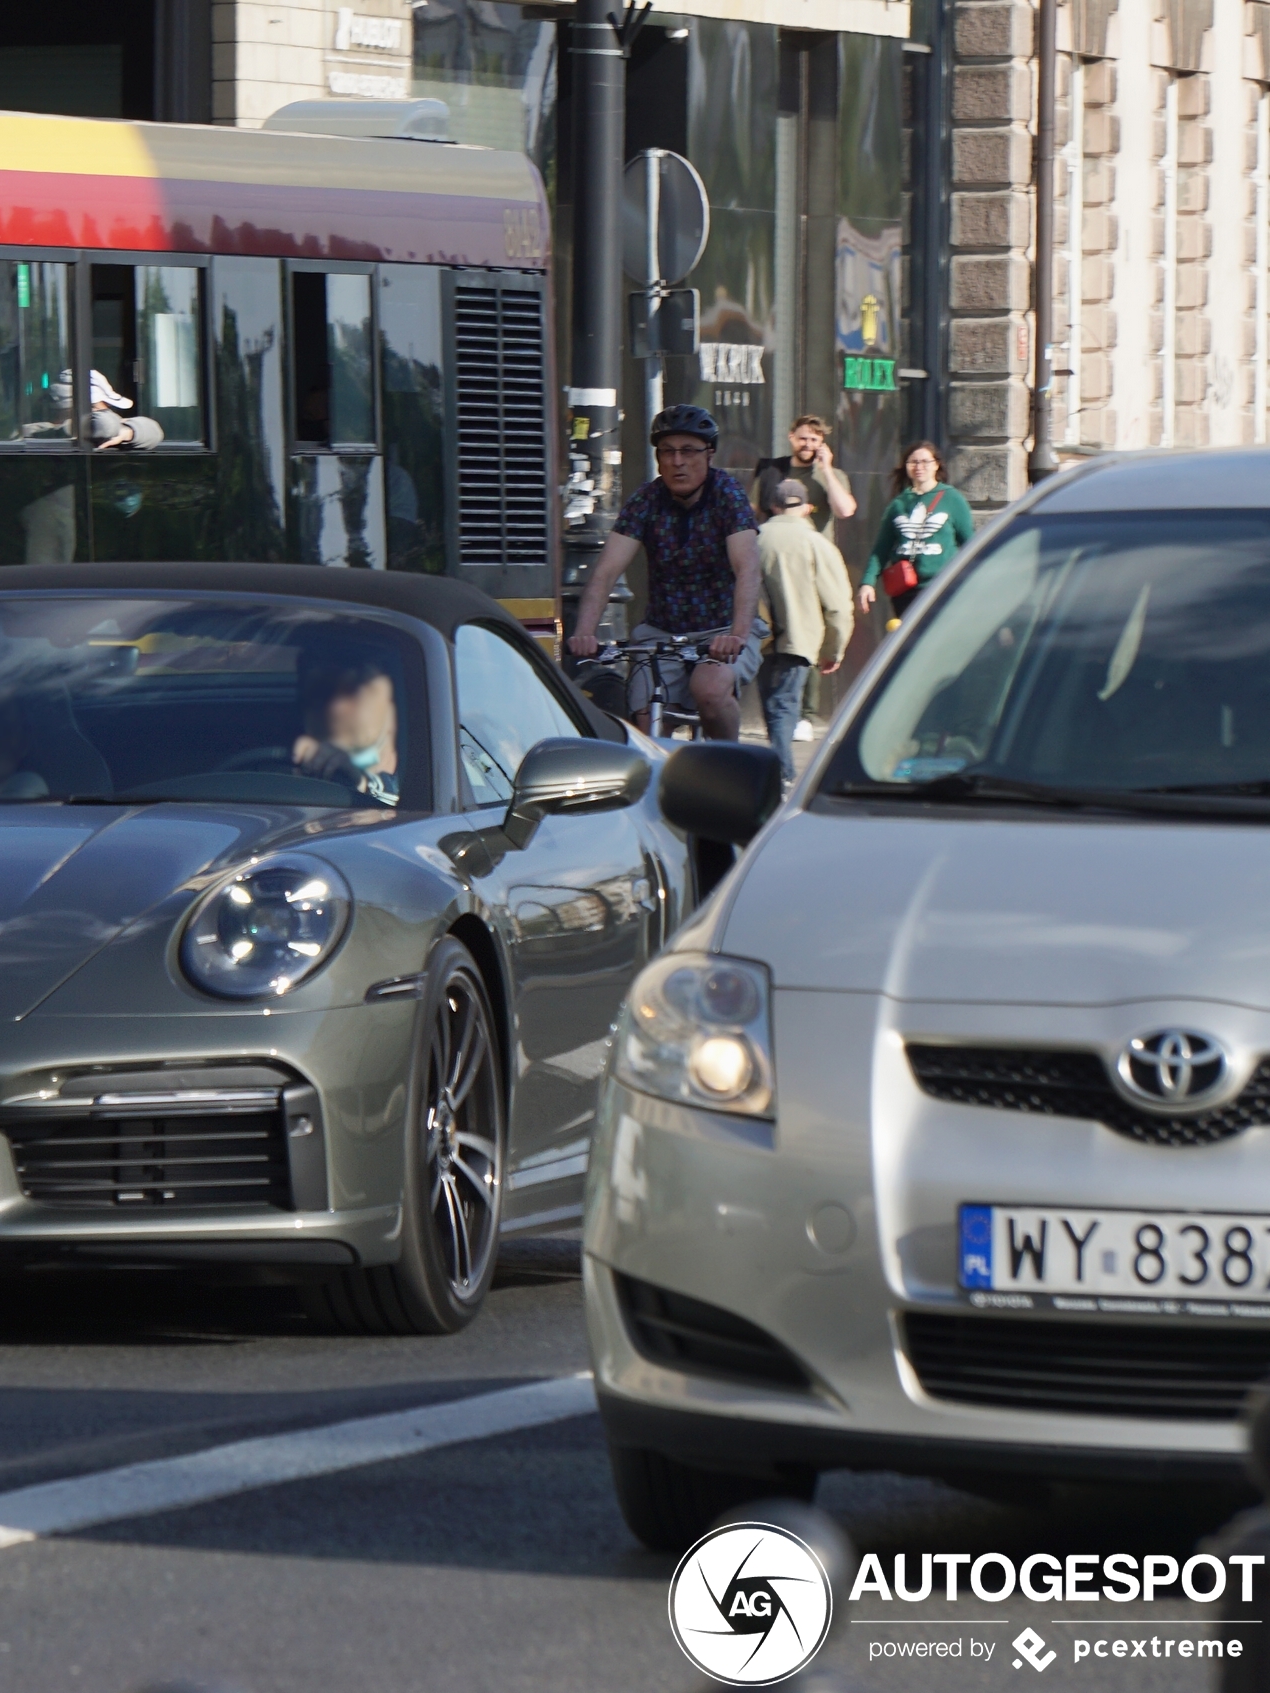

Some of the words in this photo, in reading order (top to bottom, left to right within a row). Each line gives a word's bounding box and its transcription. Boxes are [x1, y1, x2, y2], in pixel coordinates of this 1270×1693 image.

[844, 357, 896, 391] ROLEX
[964, 1254, 990, 1276] PL
[1007, 1216, 1100, 1281] WY
[1133, 1223, 1270, 1292] 838
